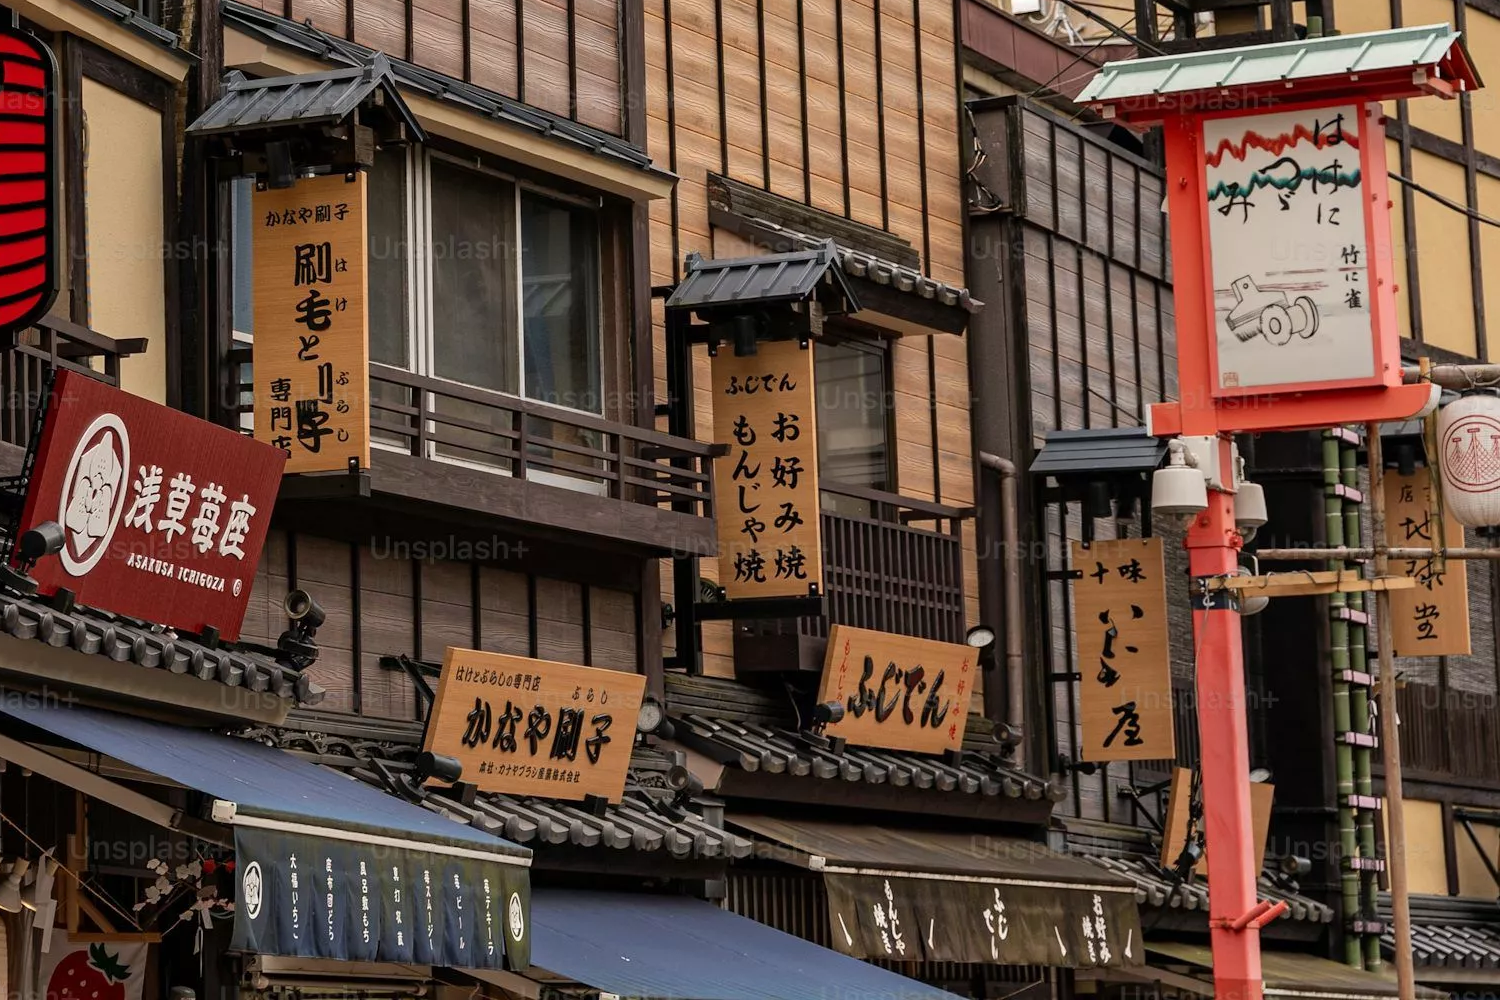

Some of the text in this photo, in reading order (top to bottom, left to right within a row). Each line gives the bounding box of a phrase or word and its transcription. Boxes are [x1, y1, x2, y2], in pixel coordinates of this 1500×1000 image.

[265, 203, 350, 227] かなや刷子
[1341, 244, 1363, 309] 竹に雀
[725, 373, 797, 395] ふじでん
[124, 464, 257, 560] 浅草苺座
[732, 415, 767, 583] もんじゃ焼
[770, 412, 808, 581] お好み焼
[127, 552, 174, 578] ASAKUSA
[177, 567, 225, 592] ICHIGOZA
[455, 665, 542, 692] はけとぶらしの専門店
[572, 686, 608, 704] ぶらし
[847, 654, 950, 729] ふじでん
[461, 697, 613, 765] かなや刷子
